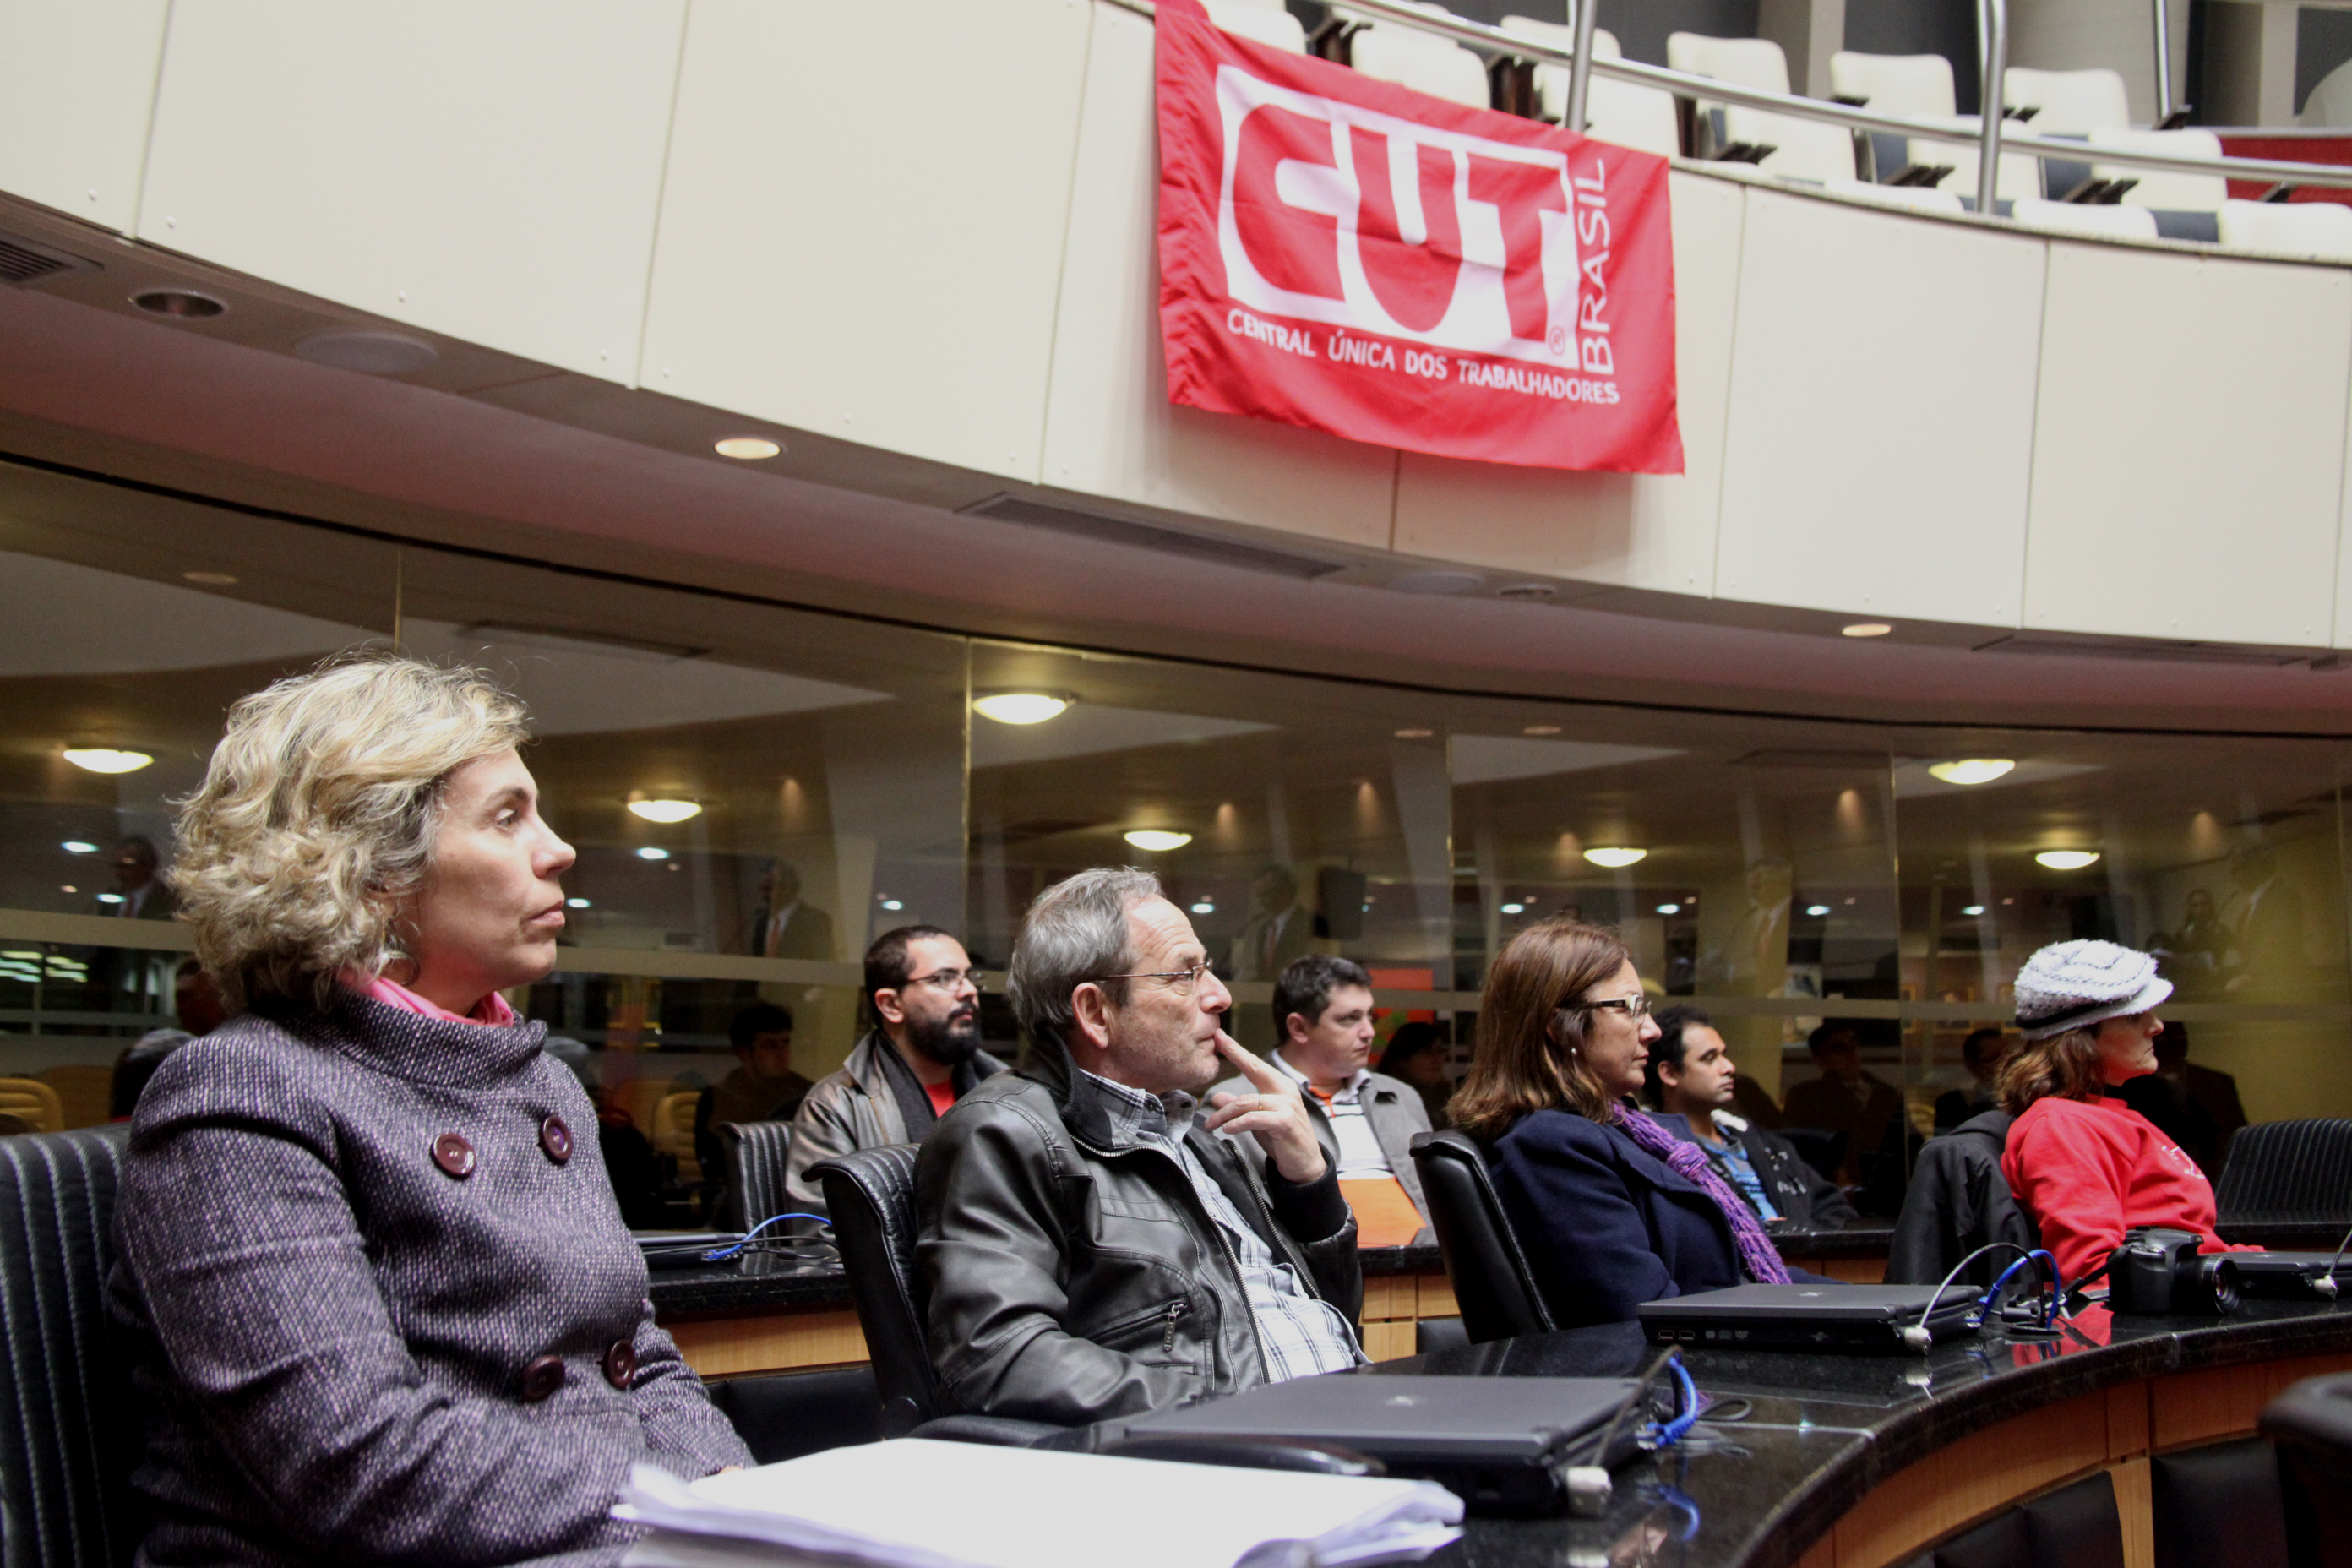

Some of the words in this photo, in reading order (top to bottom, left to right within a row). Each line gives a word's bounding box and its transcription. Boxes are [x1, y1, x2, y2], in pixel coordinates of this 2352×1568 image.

[1233, 103, 1567, 344] CUT
[1575, 158, 1614, 375] BRASIL
[1228, 308, 1316, 357] CENTRAL
[1328, 328, 1396, 371] ÚNICA
[1404, 349, 1448, 380] DOS
[1456, 358, 1620, 405] TRABALHADORES
